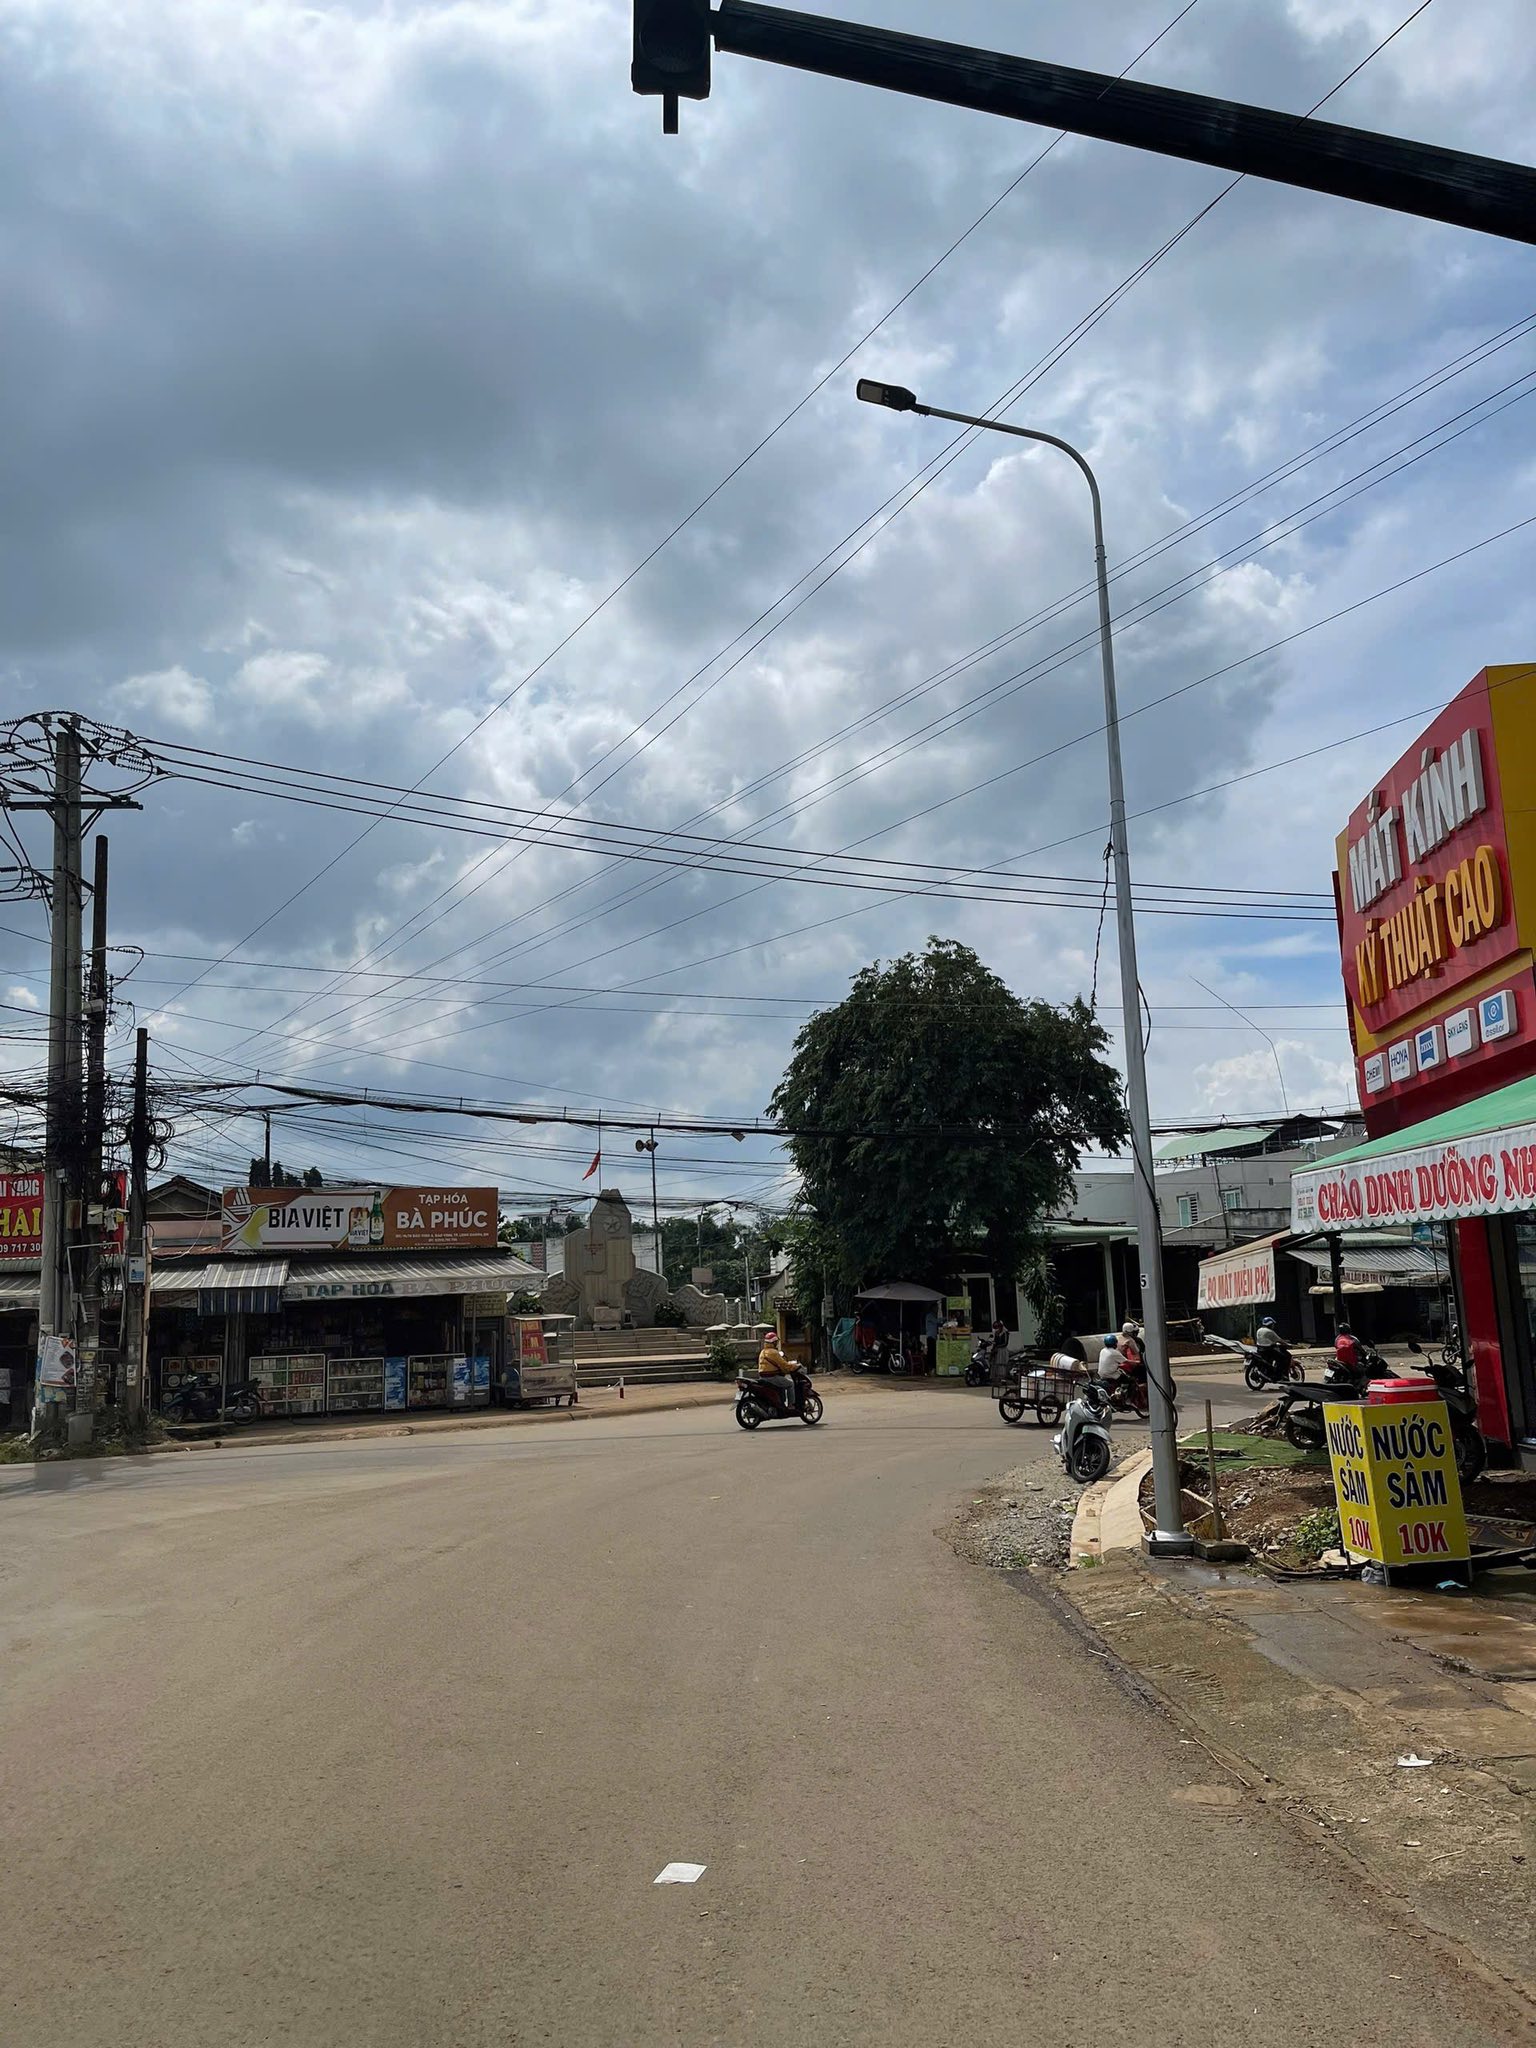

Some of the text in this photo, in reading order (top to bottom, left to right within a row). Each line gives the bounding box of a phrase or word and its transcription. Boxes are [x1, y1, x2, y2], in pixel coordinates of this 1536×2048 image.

[1349, 728, 1486, 914] MẮT KÍNH
[1355, 845, 1500, 1008] KỸ THUẬT CAO
[1391, 1047, 1409, 1068] HOYA
[419, 1192, 468, 1206] TẠP HÓA
[1317, 1143, 1536, 1222] CHÁO DINH DƯỠNG NH
[268, 1205, 344, 1231] BIA VIỆT
[396, 1206, 488, 1229] BÀ PHÚC
[11, 1243, 28, 1252] 717
[1328, 1415, 1364, 1460] NƯỚC
[1371, 1413, 1446, 1461] NƯỚC
[1340, 1460, 1370, 1506] SÂM
[1387, 1461, 1448, 1509] SÂM
[1349, 1517, 1373, 1551] 10K
[1399, 1521, 1449, 1555] 10K
